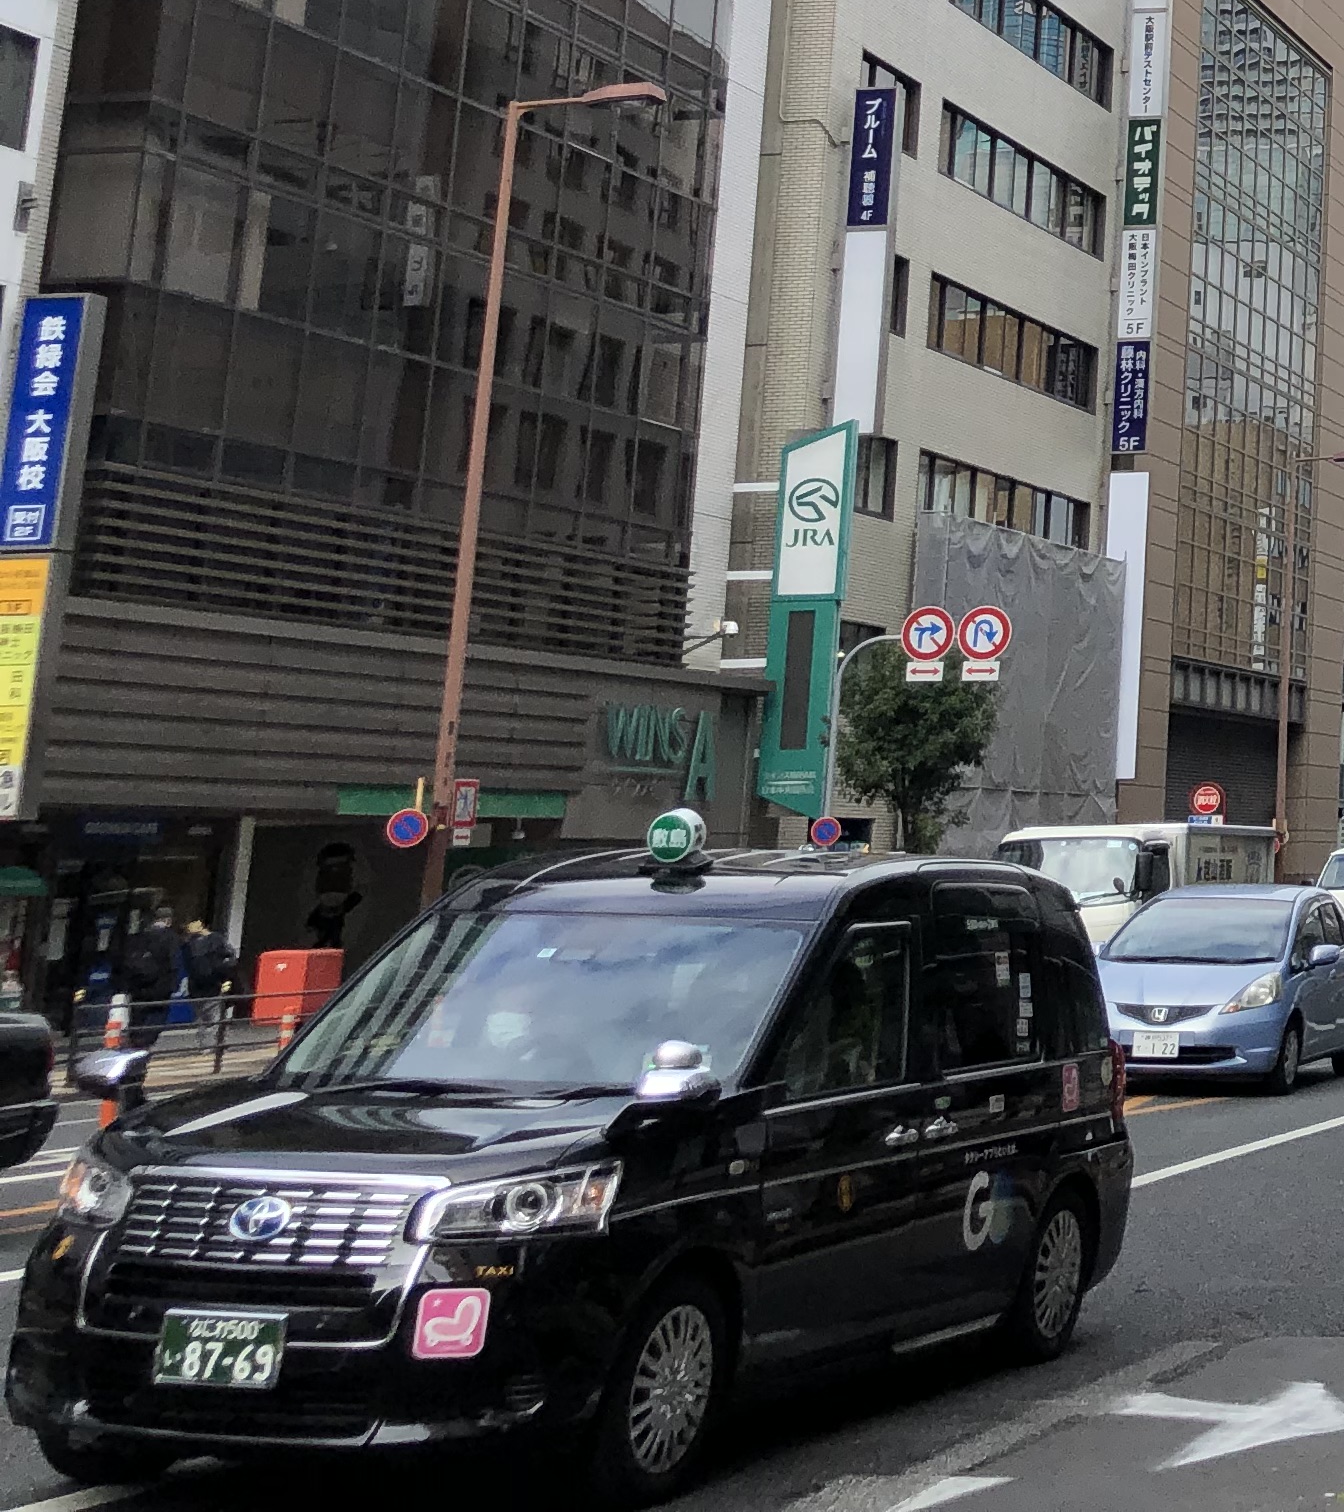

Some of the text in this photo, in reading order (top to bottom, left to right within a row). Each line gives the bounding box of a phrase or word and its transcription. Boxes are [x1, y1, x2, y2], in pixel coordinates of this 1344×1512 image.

[1142, 15, 1155, 114] 大阪駅前テストセンター
[1131, 124, 1158, 220] バイオテック
[860, 210, 873, 221] 4F
[1126, 233, 1138, 316] 大阪梅田クリニック
[1126, 322, 1144, 335] 5F
[18, 316, 67, 491] 鉄緑会 大阪校
[1119, 436, 1140, 451] 5F
[786, 528, 835, 549] JRA
[605, 702, 688, 764] WINS
[475, 1264, 515, 1277] TAXI
[182, 1341, 276, 1382] 87-69
